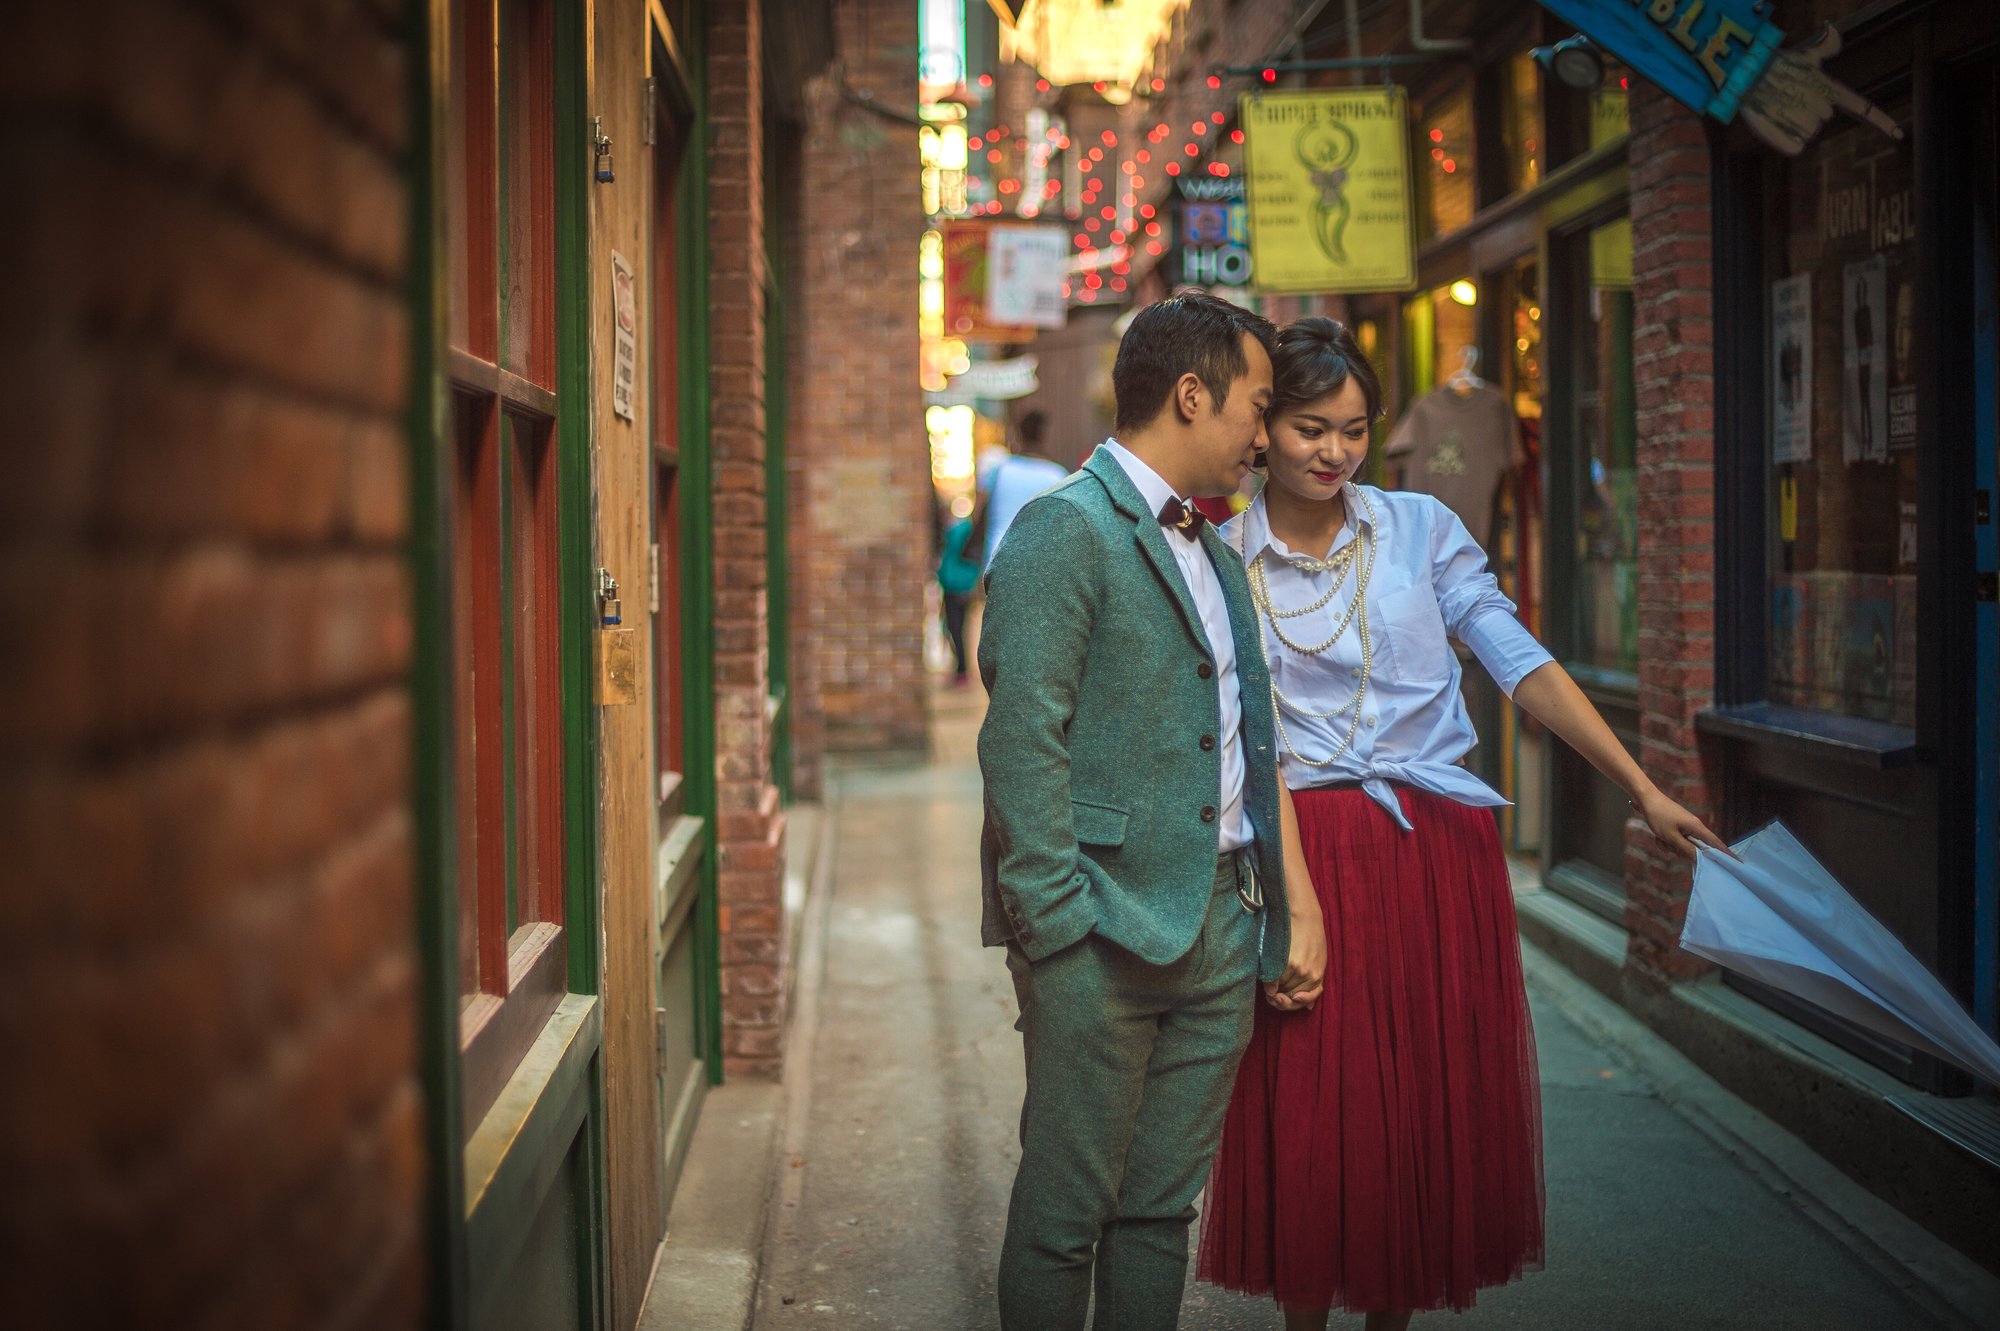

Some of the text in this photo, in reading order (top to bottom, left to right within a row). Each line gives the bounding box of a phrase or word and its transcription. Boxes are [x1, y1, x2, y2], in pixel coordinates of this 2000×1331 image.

[1632, 0, 1755, 93] BLE
[1853, 147, 1916, 251] TABL
[1183, 245, 1254, 286] HO
